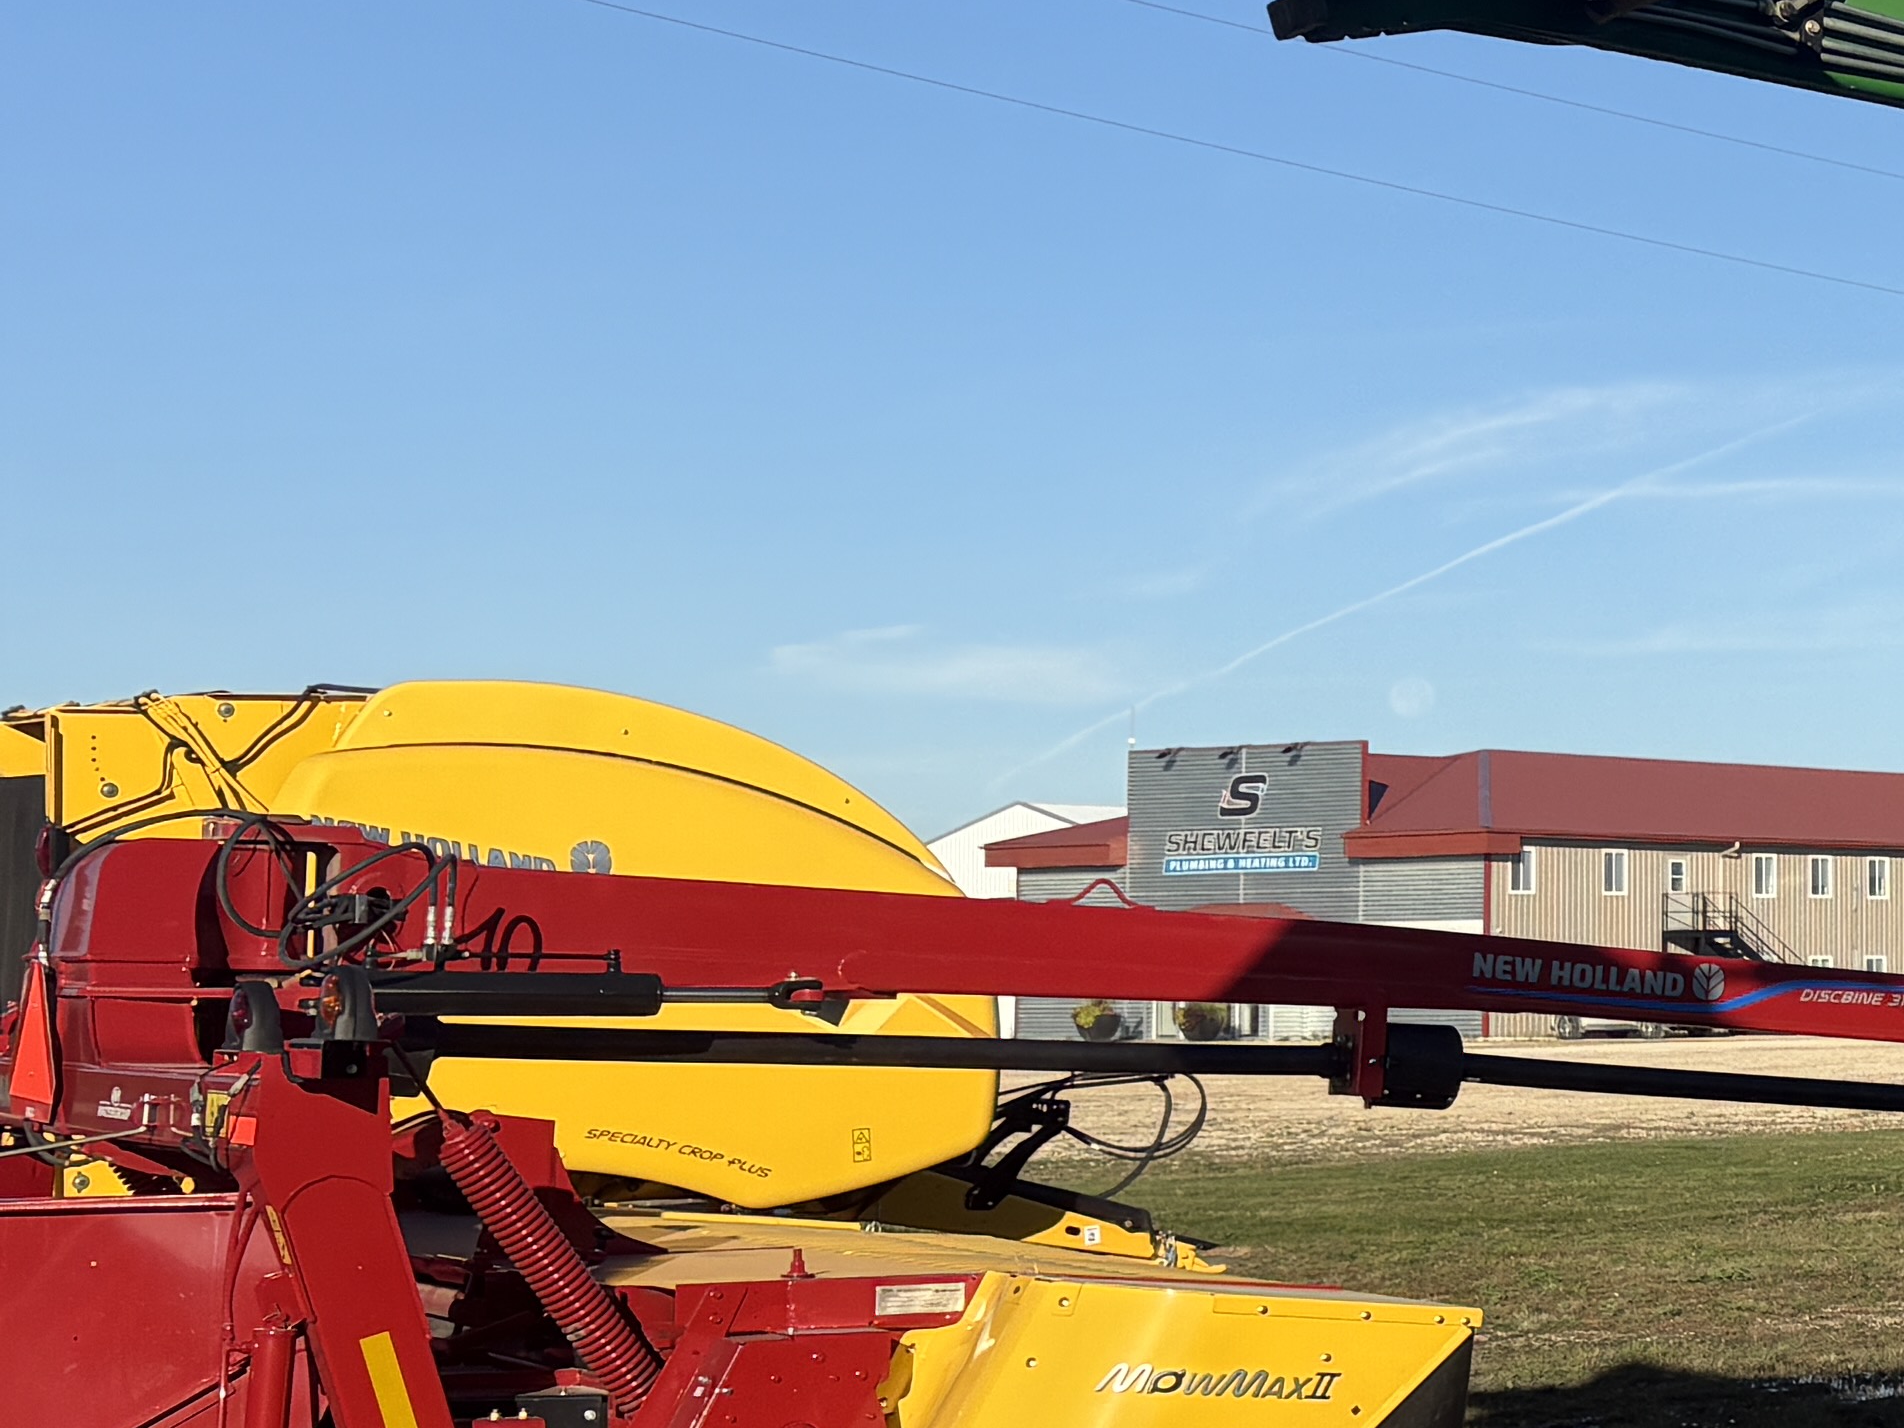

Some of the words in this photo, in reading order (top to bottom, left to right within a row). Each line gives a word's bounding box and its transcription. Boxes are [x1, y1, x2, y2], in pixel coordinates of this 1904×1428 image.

[1218, 773, 1269, 819] S
[1165, 827, 1322, 854] SHEWFELT'S
[1169, 857, 1224, 871] PLUMBING
[1227, 858, 1235, 869] &
[1239, 856, 1285, 869] HEATING
[1473, 951, 1542, 983] NEW
[1551, 960, 1685, 998] HOLLAND
[1800, 988, 1885, 1006] DISCBINE
[585, 1128, 677, 1151] SPECIALTY
[678, 1144, 725, 1162] CROP
[727, 1157, 772, 1179] PLUS
